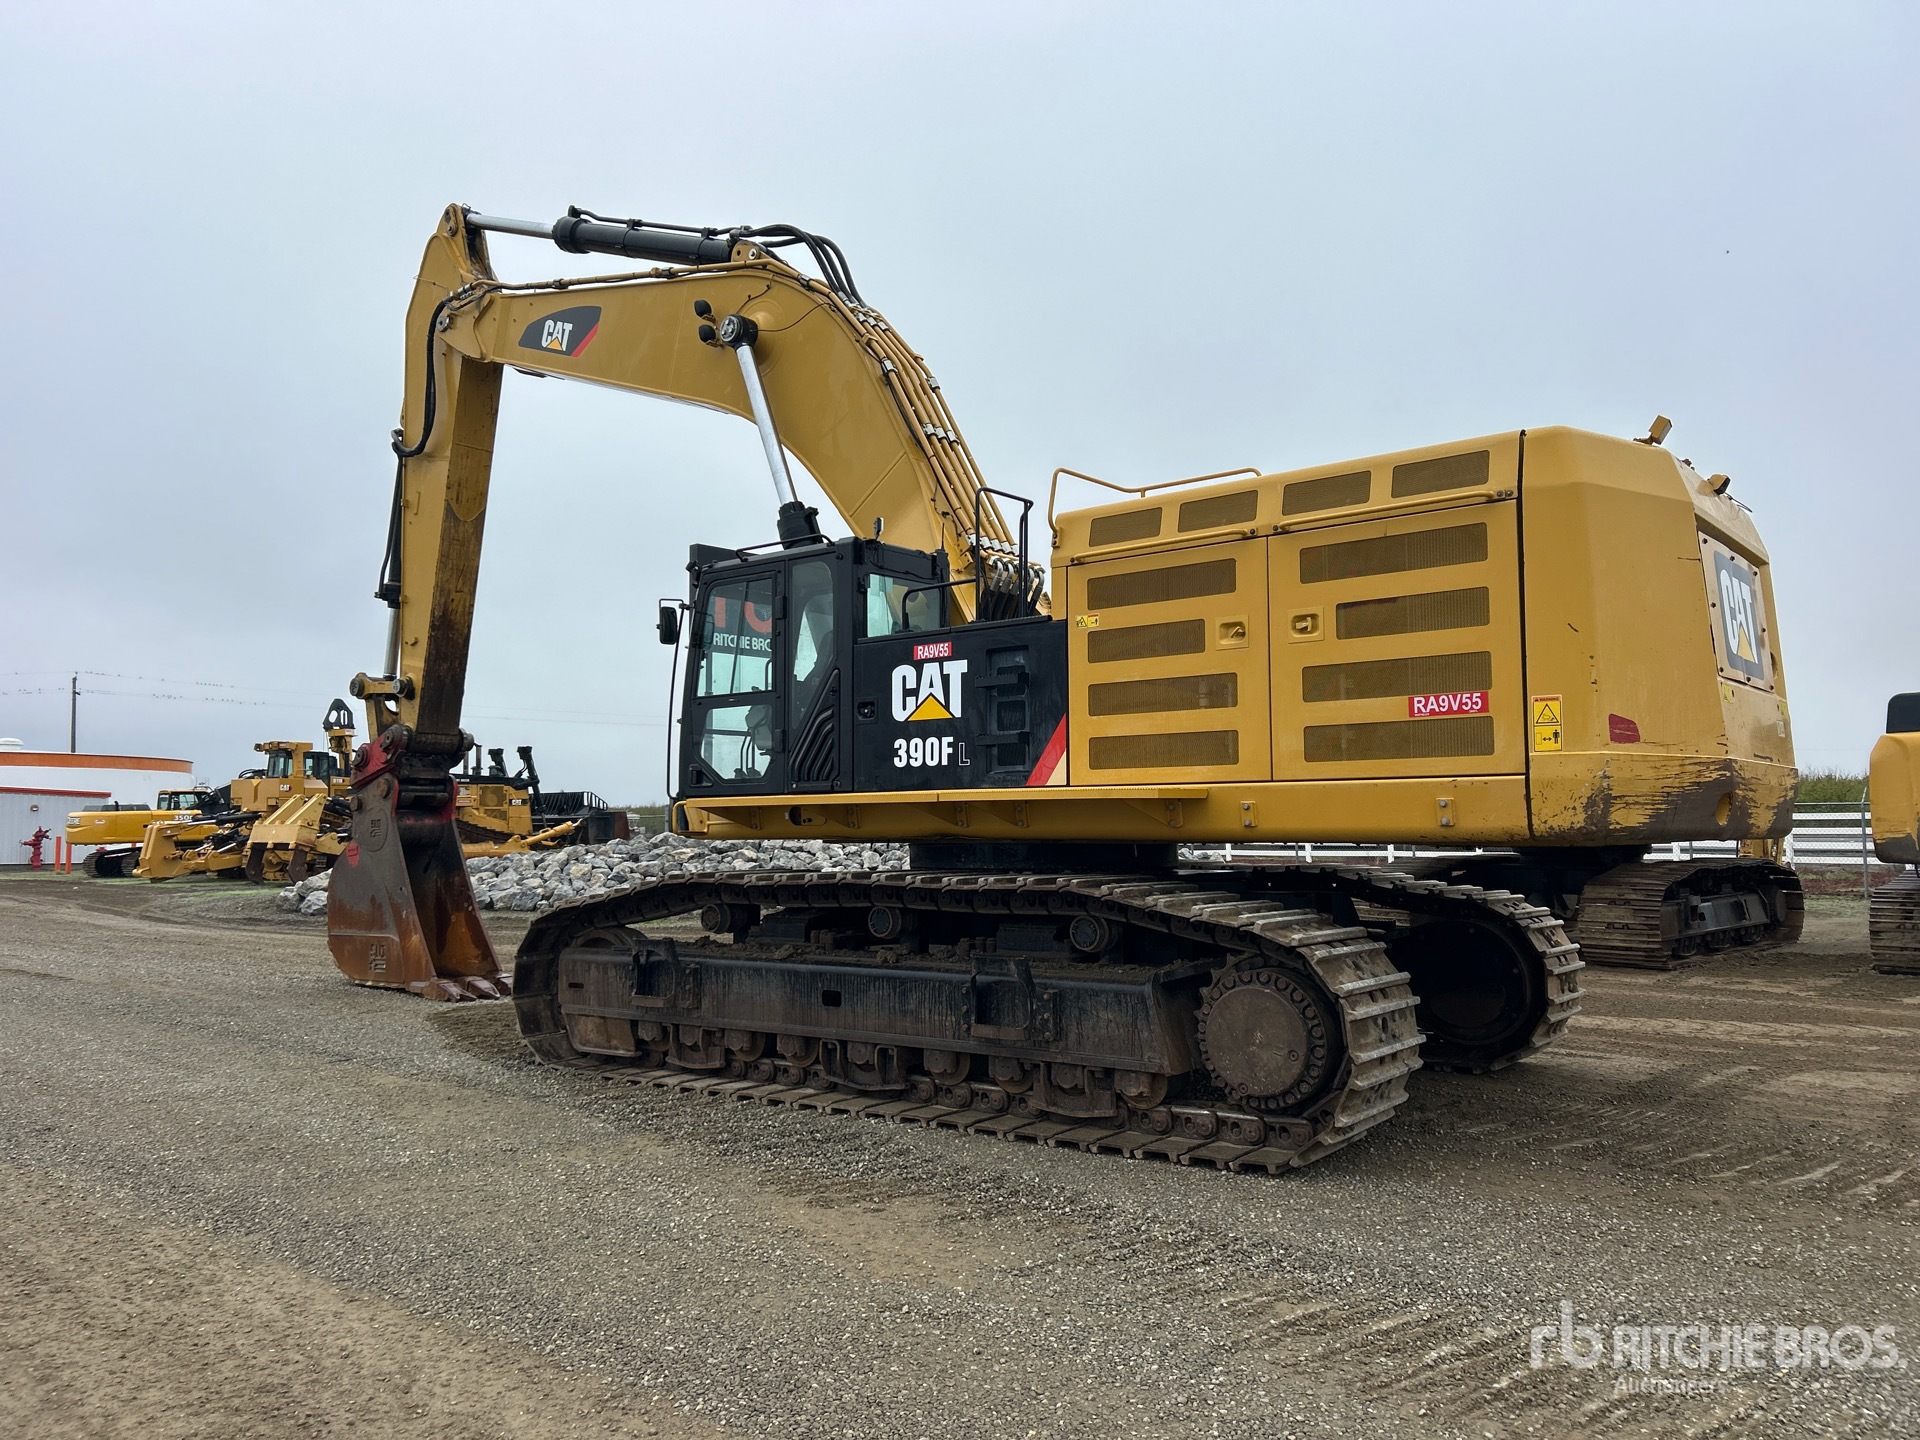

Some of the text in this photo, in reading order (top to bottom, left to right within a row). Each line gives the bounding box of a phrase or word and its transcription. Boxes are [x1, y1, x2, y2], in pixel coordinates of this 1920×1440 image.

[541, 319, 573, 351] CAT
[1720, 568, 1759, 664] CAT
[917, 643, 949, 660] RA9V55
[891, 659, 968, 722] CAT
[1413, 692, 1483, 714] RA9V55
[893, 736, 971, 768] 390F L
